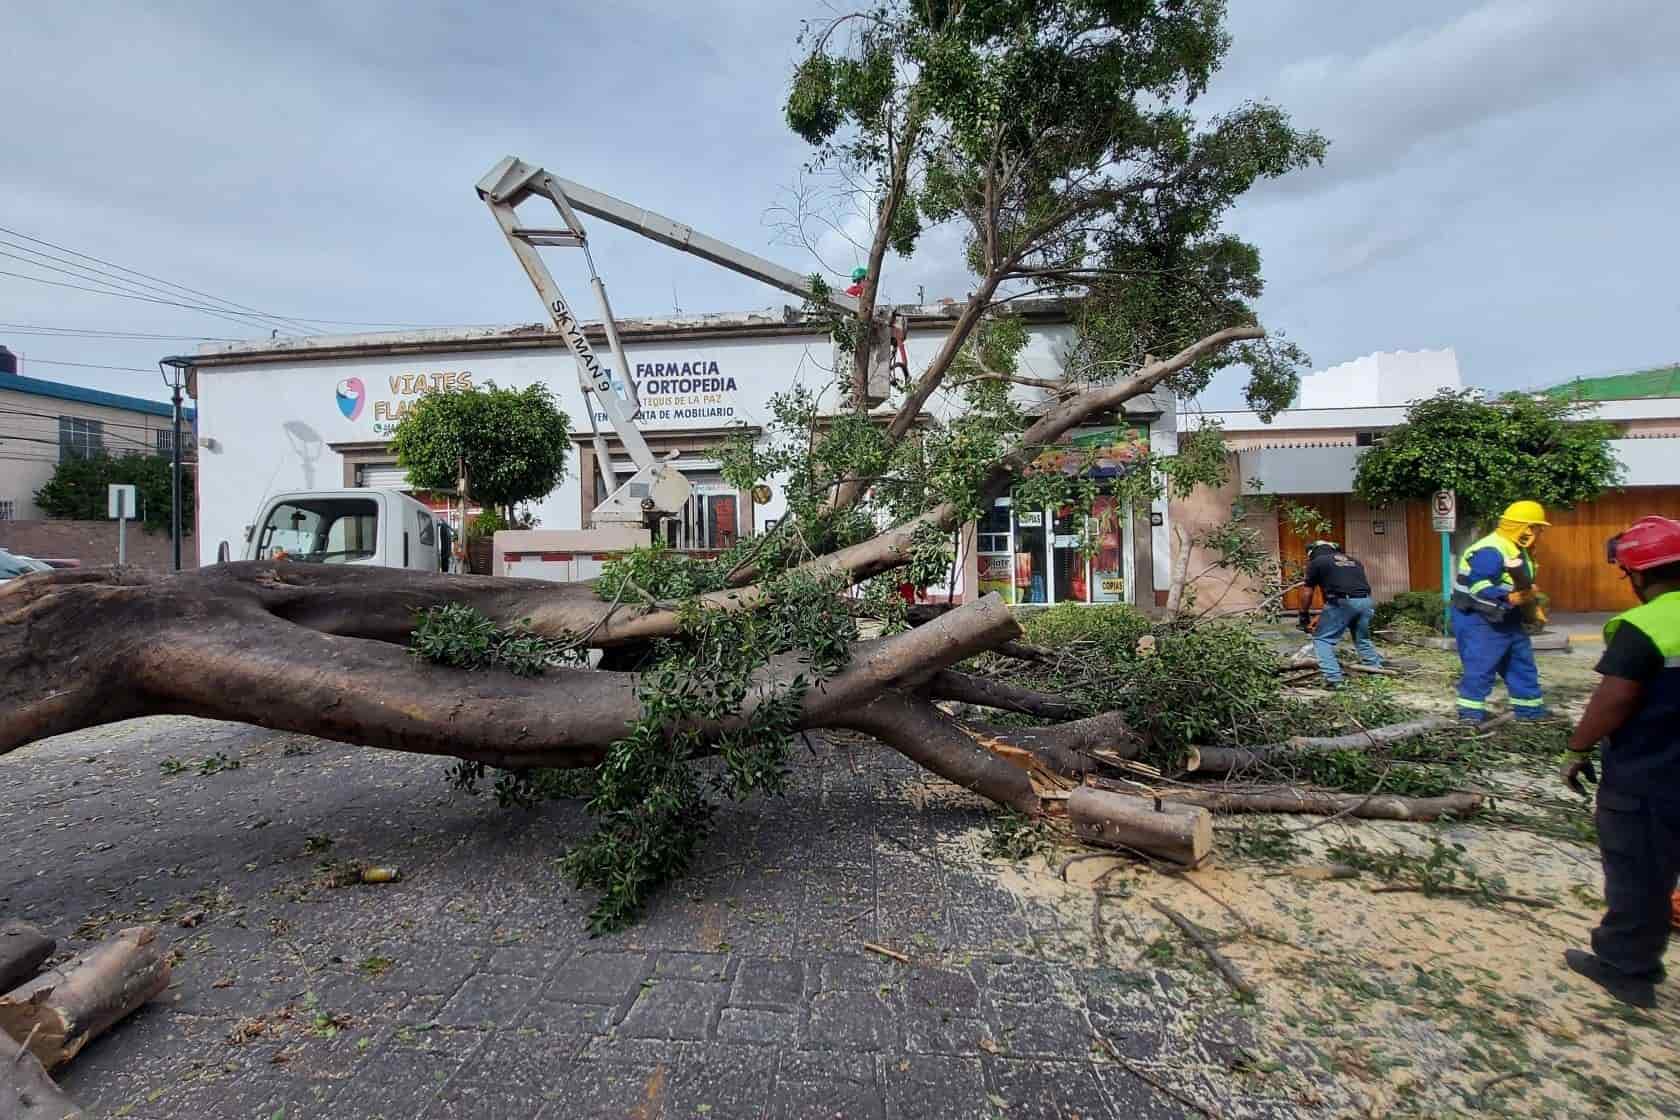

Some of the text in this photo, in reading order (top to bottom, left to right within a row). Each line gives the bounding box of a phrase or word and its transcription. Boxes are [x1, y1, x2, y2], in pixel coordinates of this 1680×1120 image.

[551, 300, 610, 392] SKYMAN 9
[636, 361, 720, 378] FARMACIA
[389, 372, 472, 394] VIAJES
[646, 377, 737, 395] ORTOPEDIA
[674, 397, 686, 405] DE
[688, 395, 700, 404] LA
[703, 394, 722, 404] PAZ
[659, 410, 670, 419] DE
[673, 407, 734, 418] MOBILIARIO
[1102, 581, 1123, 591] COPIAS
